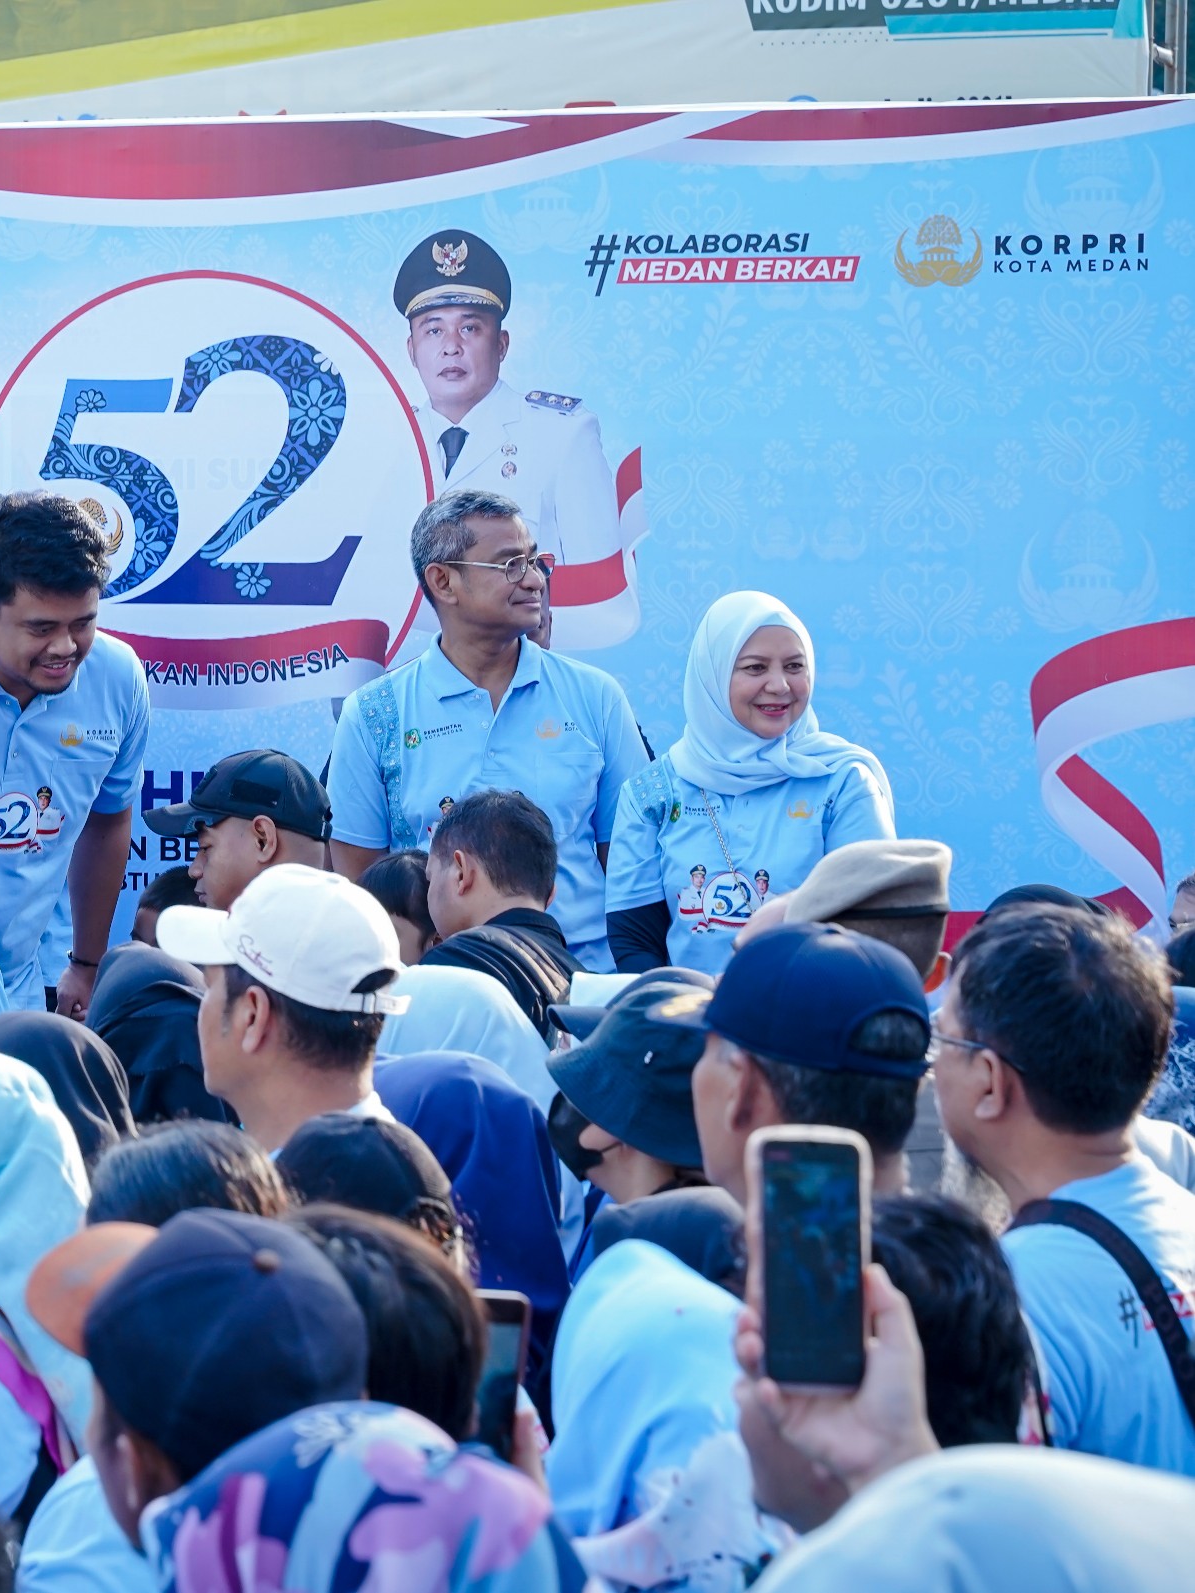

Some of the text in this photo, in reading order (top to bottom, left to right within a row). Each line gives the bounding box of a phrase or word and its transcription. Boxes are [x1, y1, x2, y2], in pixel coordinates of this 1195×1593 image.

[994, 233, 1145, 256] KORPRI
[622, 258, 855, 282] MEDAN BERKAH
[994, 258, 1149, 273] KOTA MEDAN
[39, 335, 363, 606] 52
[143, 643, 350, 686] KAN INDONESIA
[710, 881, 756, 918] 52
